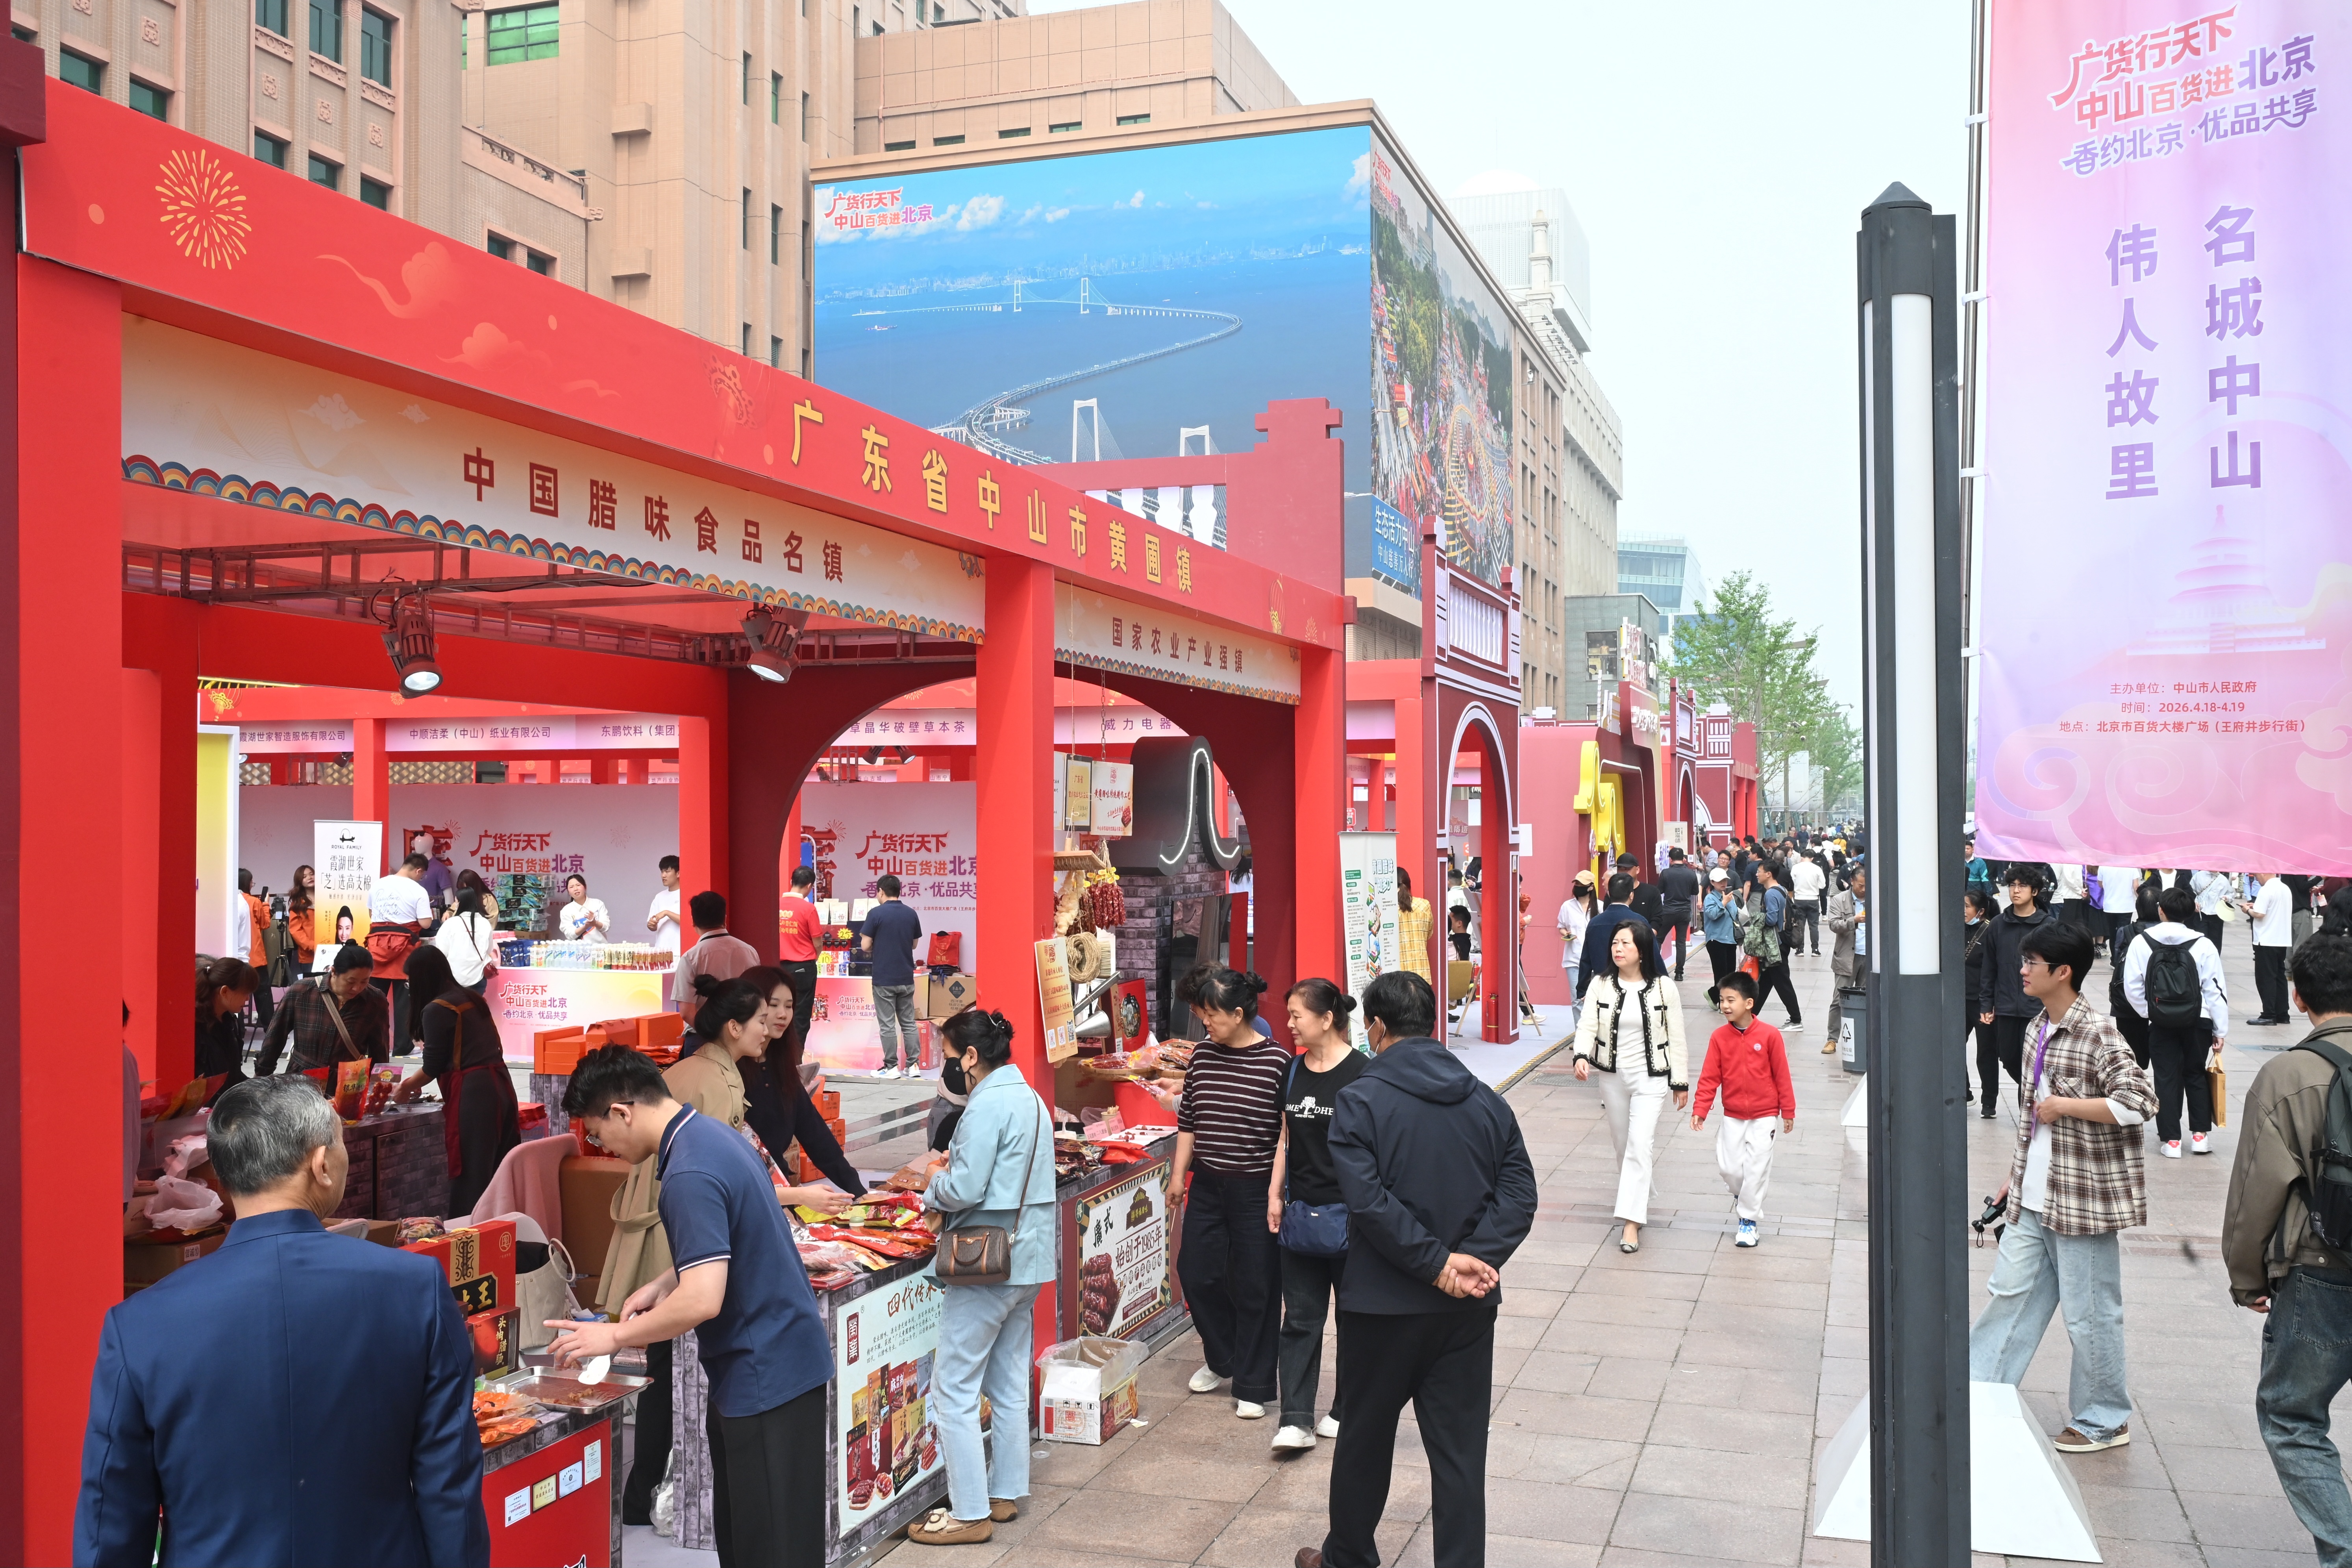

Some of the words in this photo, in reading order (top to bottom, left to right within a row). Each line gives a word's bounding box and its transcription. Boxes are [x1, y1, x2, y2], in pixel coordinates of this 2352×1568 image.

[2050, 4, 2238, 106] 广货行天下
[2077, 34, 2315, 129] 中山百货进北京
[2062, 88, 2317, 175] 香约北京·优品共享
[824, 187, 903, 218] 广货行天下
[835, 205, 933, 230] 中山百货进北京
[2204, 205, 2263, 489] 名城中山
[2105, 223, 2159, 500] 伟人故里
[791, 399, 1192, 594] 广东省中山市黄圃镇
[464, 447, 843, 583] 中国腊味食品名镇
[1375, 505, 1414, 554] 生态活力中山
[1378, 542, 1413, 578] 中山慈善万人行
[1112, 617, 1243, 674] 国家农业产业强镇
[2110, 681, 2257, 694] 主办单位：中山市人民政府
[2121, 702, 2245, 714] 时间：2026.4.18-4.19
[240, 731, 345, 742] 霞湖世家智造服饰有限公司
[409, 727, 551, 739] 中顺洁柔（中山）纸业有限公司
[850, 721, 965, 733] 草晶华破壁草本茶
[1105, 718, 1182, 731] 威力电器
[2059, 719, 2305, 733] 地点：北京市百货大楼广场（王府井步行街）
[469, 829, 551, 856] 广货行天下
[855, 830, 948, 859] 广货行天下
[330, 855, 364, 872] 霞湖世家
[480, 853, 585, 873] 中山百货进北京
[500, 981, 548, 998] 广货行天下
[506, 996, 567, 1008] 中山百货进北京
[836, 995, 865, 1005] 广货行天下
[503, 1009, 567, 1020] 香约北京·优品共享
[1077, 1203, 1083, 1218] 得
[1093, 1206, 1114, 1248] 廣式
[1115, 1224, 1162, 1271] 始创于1985年
[888, 1280, 946, 1318] 四代传承
[1166, 1290, 1171, 1304] 味
[496, 1315, 507, 1365] 头抽腊肠
[540, 1482, 550, 1490] 中山市
